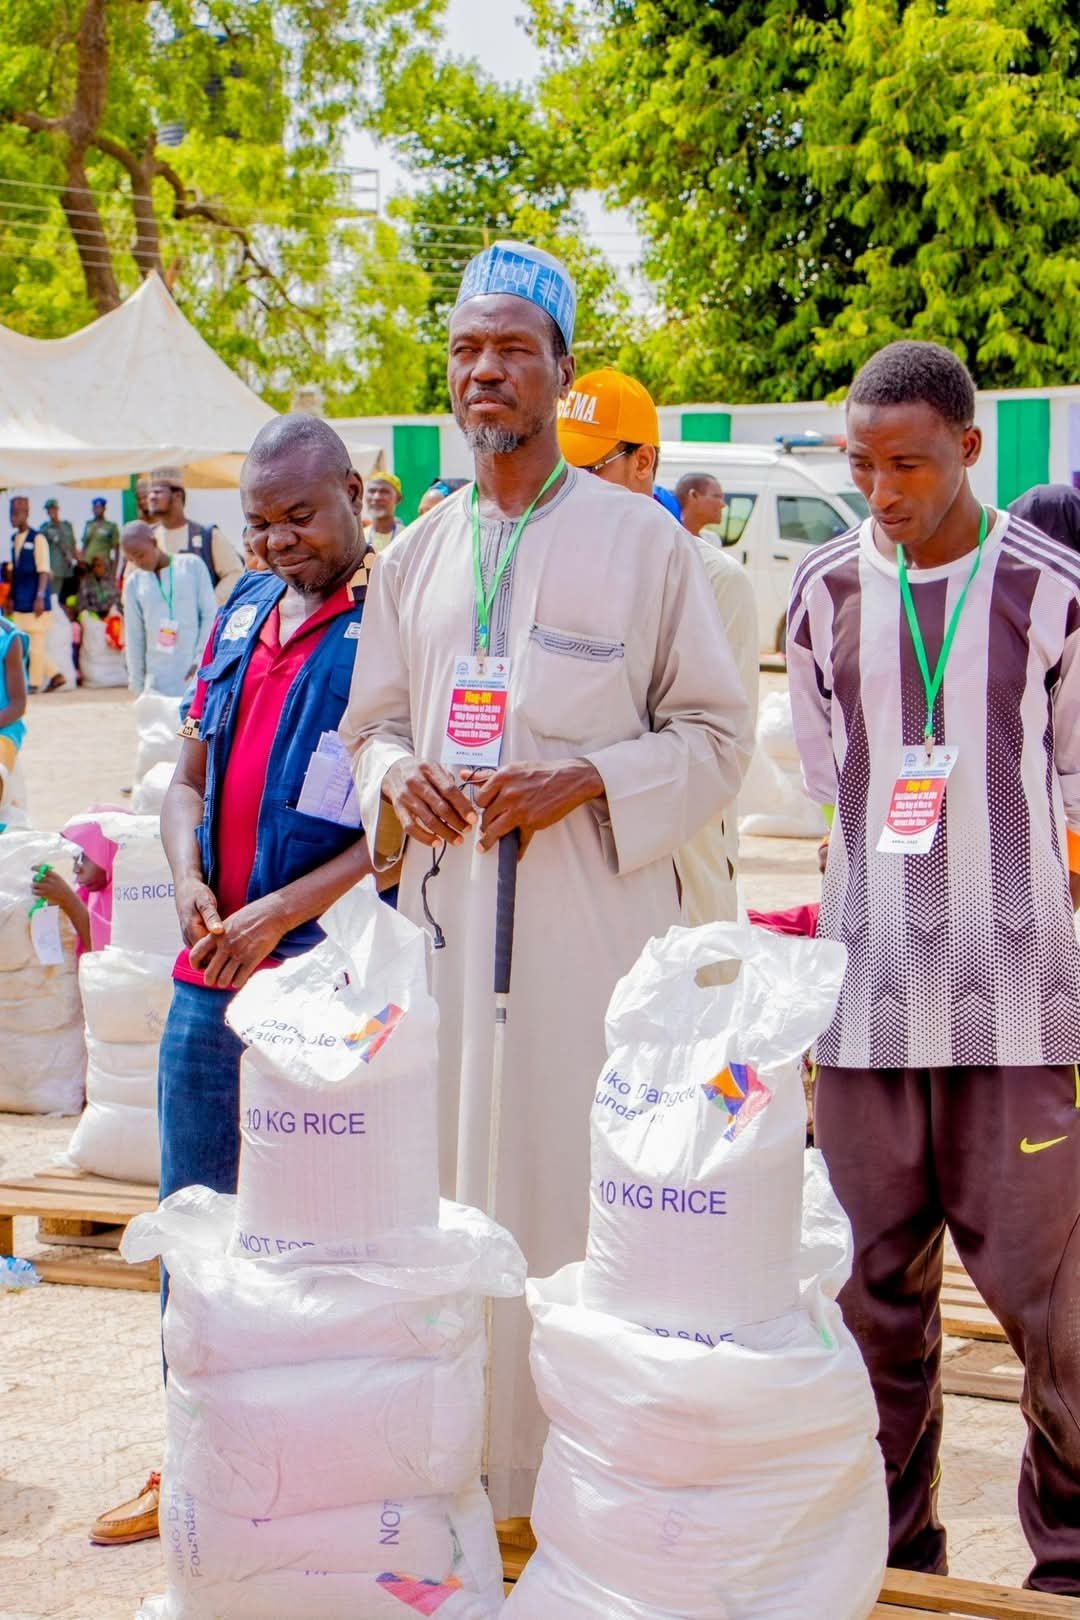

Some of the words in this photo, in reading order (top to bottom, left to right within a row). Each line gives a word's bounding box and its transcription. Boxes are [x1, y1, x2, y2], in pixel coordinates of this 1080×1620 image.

[123, 886, 138, 901] KG
[142, 883, 175, 899] RICE
[247, 1108, 261, 1131] 10
[266, 1111, 296, 1134] KG
[303, 1112, 366, 1136] RICE
[599, 1178, 617, 1205] 10
[622, 1183, 653, 1209] KG
[661, 1187, 728, 1215] RICE
[238, 1232, 271, 1255] NOT
